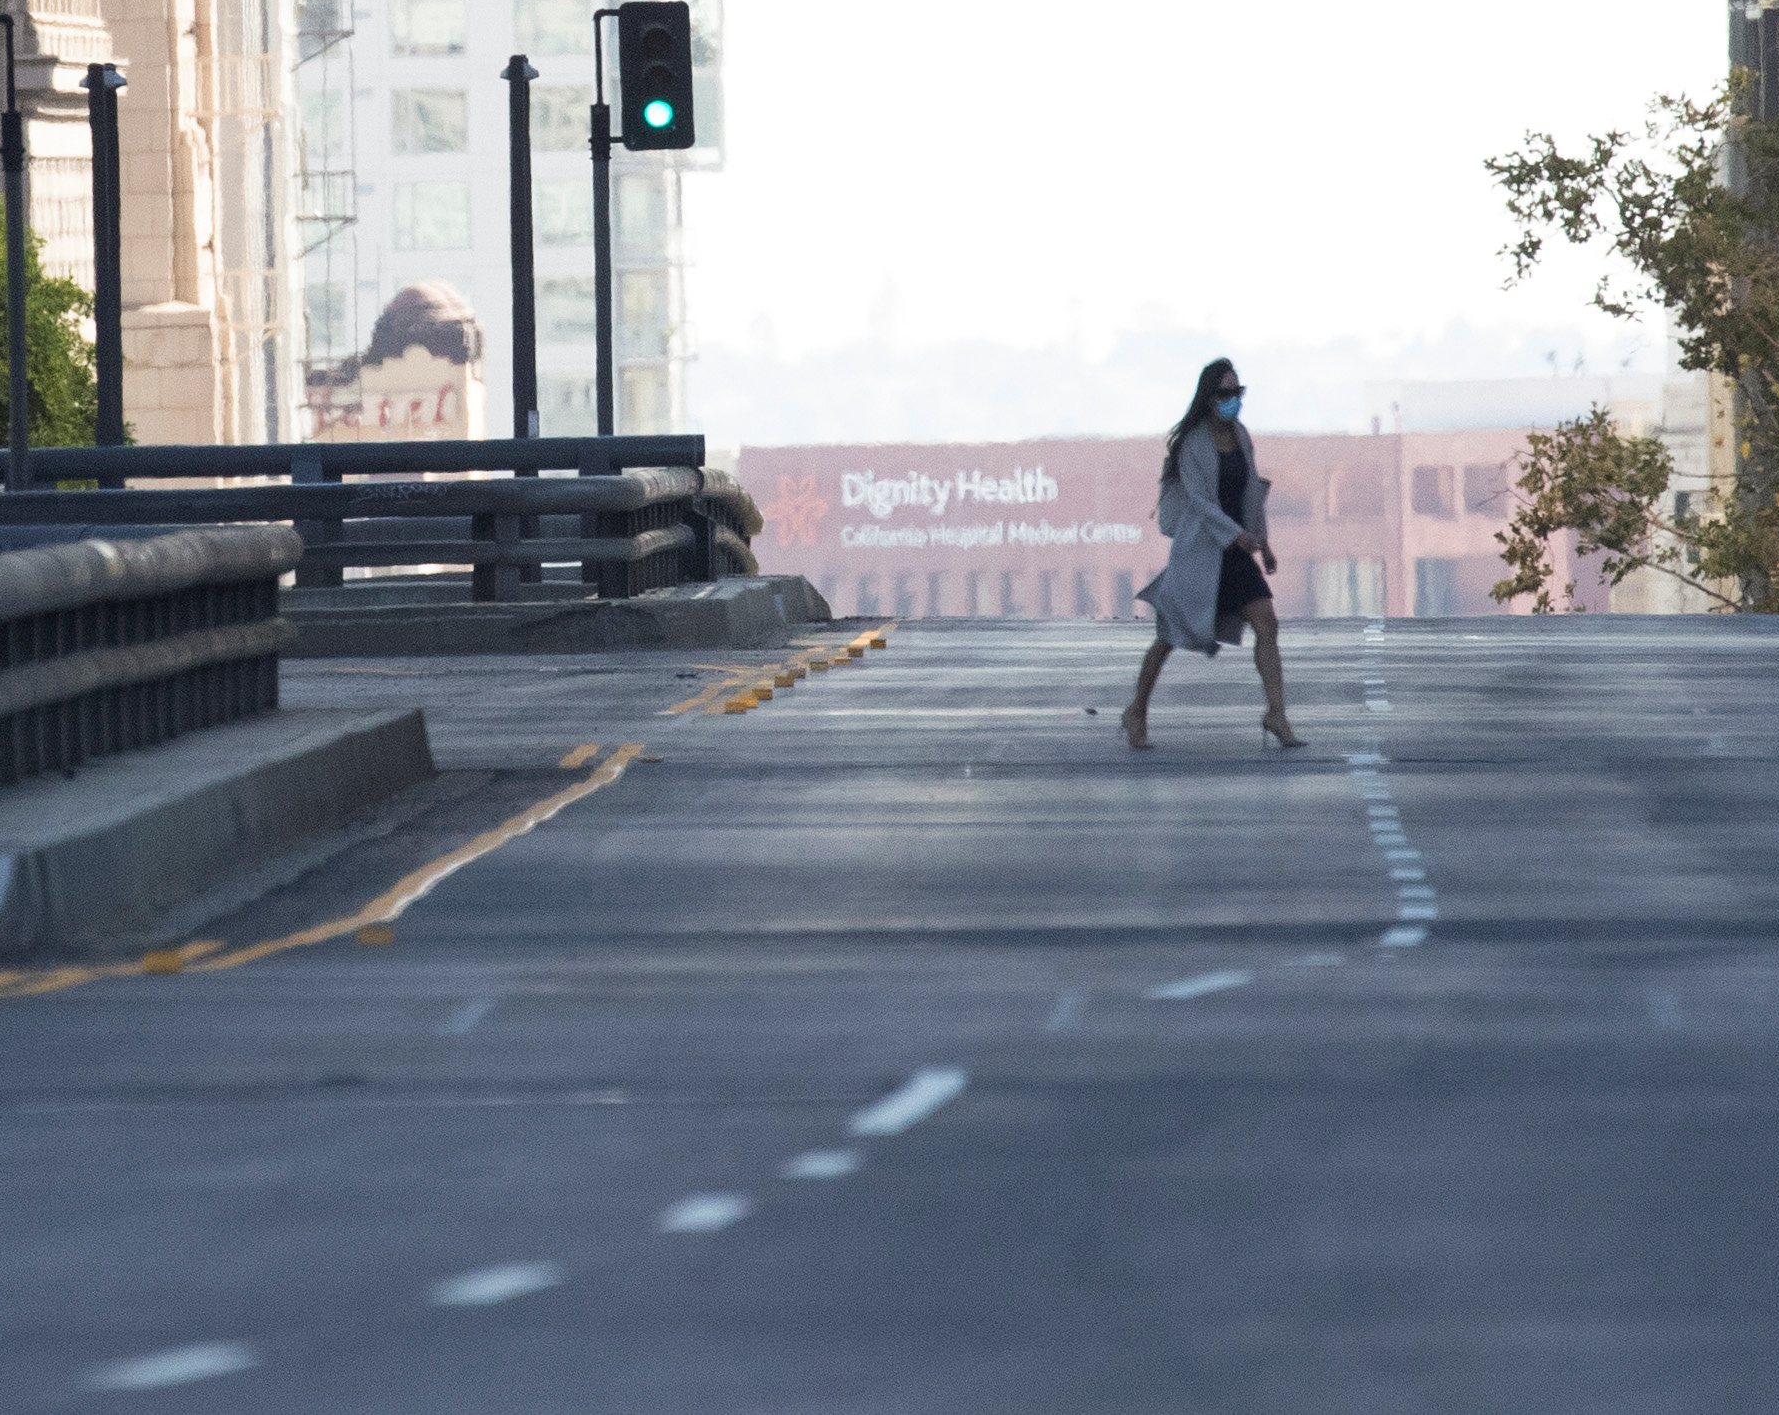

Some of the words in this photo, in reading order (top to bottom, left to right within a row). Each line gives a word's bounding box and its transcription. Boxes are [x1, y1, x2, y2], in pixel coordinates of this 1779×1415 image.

[841, 470, 952, 519] Dignity
[955, 464, 1059, 504] Health
[841, 523, 929, 548] California
[929, 521, 1005, 550] Hospital
[1007, 520, 1079, 546] Medical
[1080, 521, 1143, 545] Center
